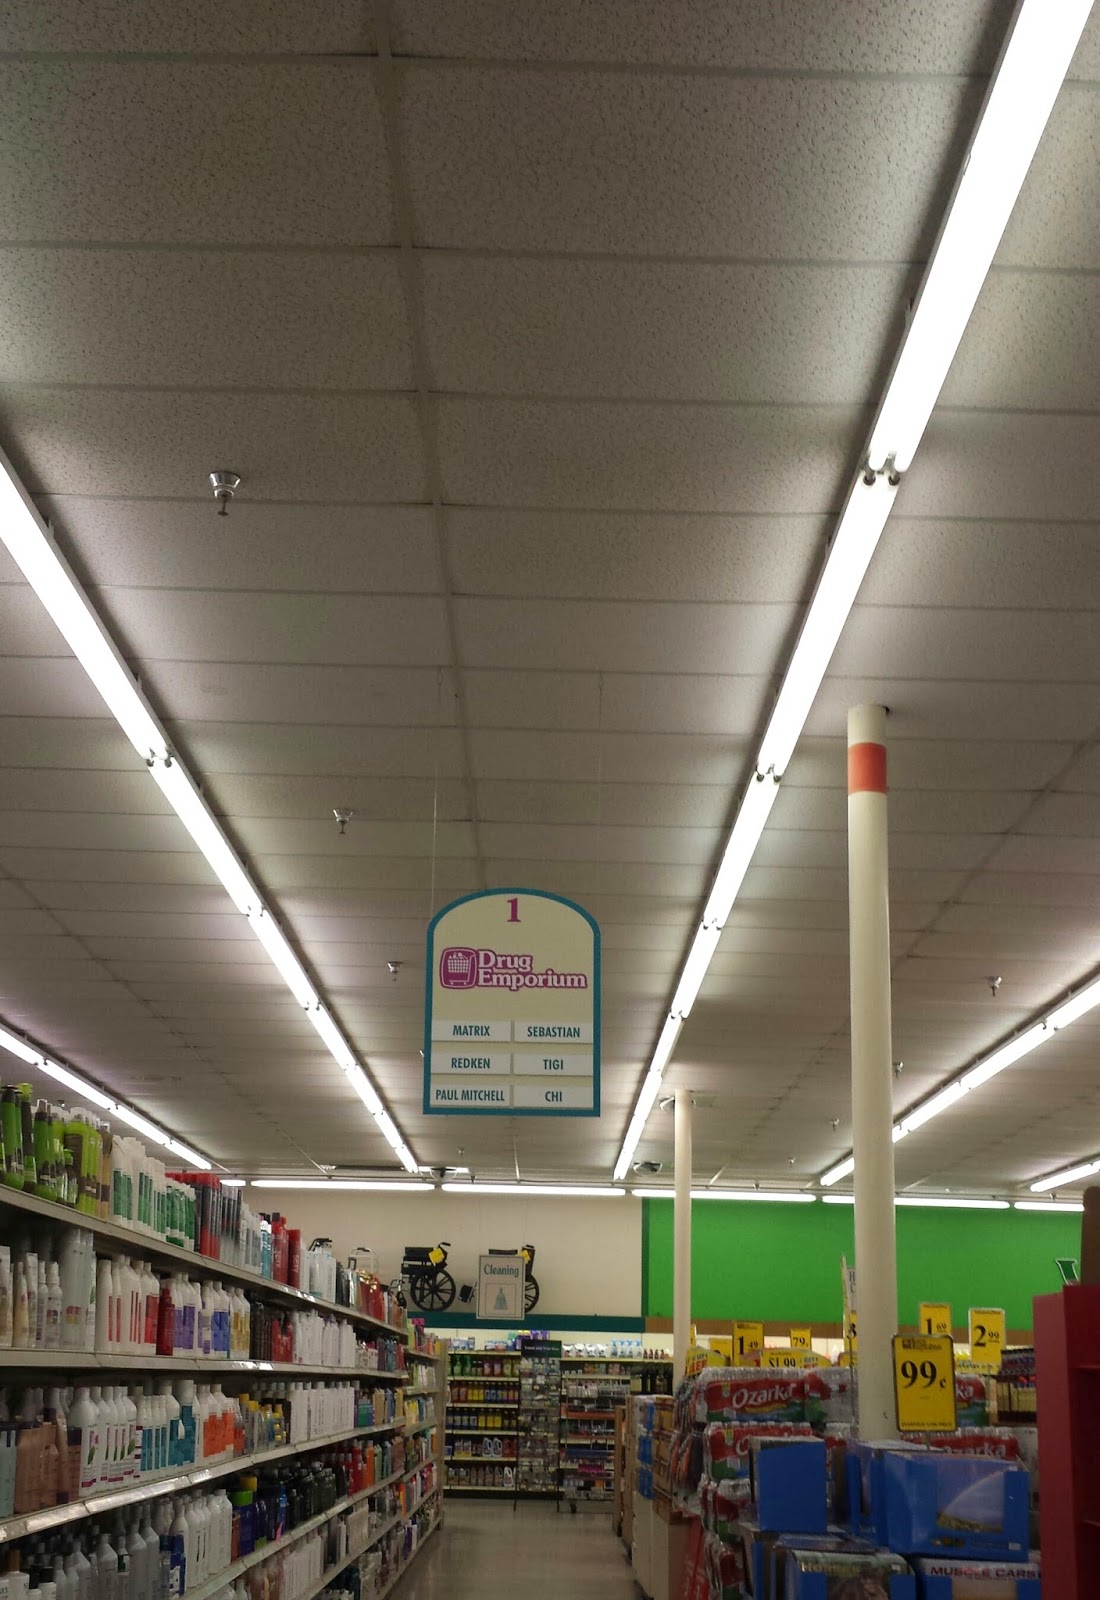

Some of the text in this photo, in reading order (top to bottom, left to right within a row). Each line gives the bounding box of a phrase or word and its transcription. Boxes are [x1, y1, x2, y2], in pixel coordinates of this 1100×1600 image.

[506, 897, 522, 923] 1
[478, 950, 533, 972] Drug
[478, 969, 587, 991] Emporium
[452, 1025, 491, 1037] MATRIX
[527, 1026, 581, 1039] SEBASTIAN
[451, 1057, 491, 1070] REDKEN
[543, 1058, 564, 1071] TIGI
[435, 1089, 506, 1103] PAUL MITCHELL
[545, 1091, 563, 1103] CHI
[483, 1263, 520, 1278] Cleaning
[973, 1324, 986, 1347] 2
[738, 1336, 745, 1355] 1
[732, 1385, 793, 1409] Ozarka
[931, 1566, 1035, 1579] MUSCLE CARS
